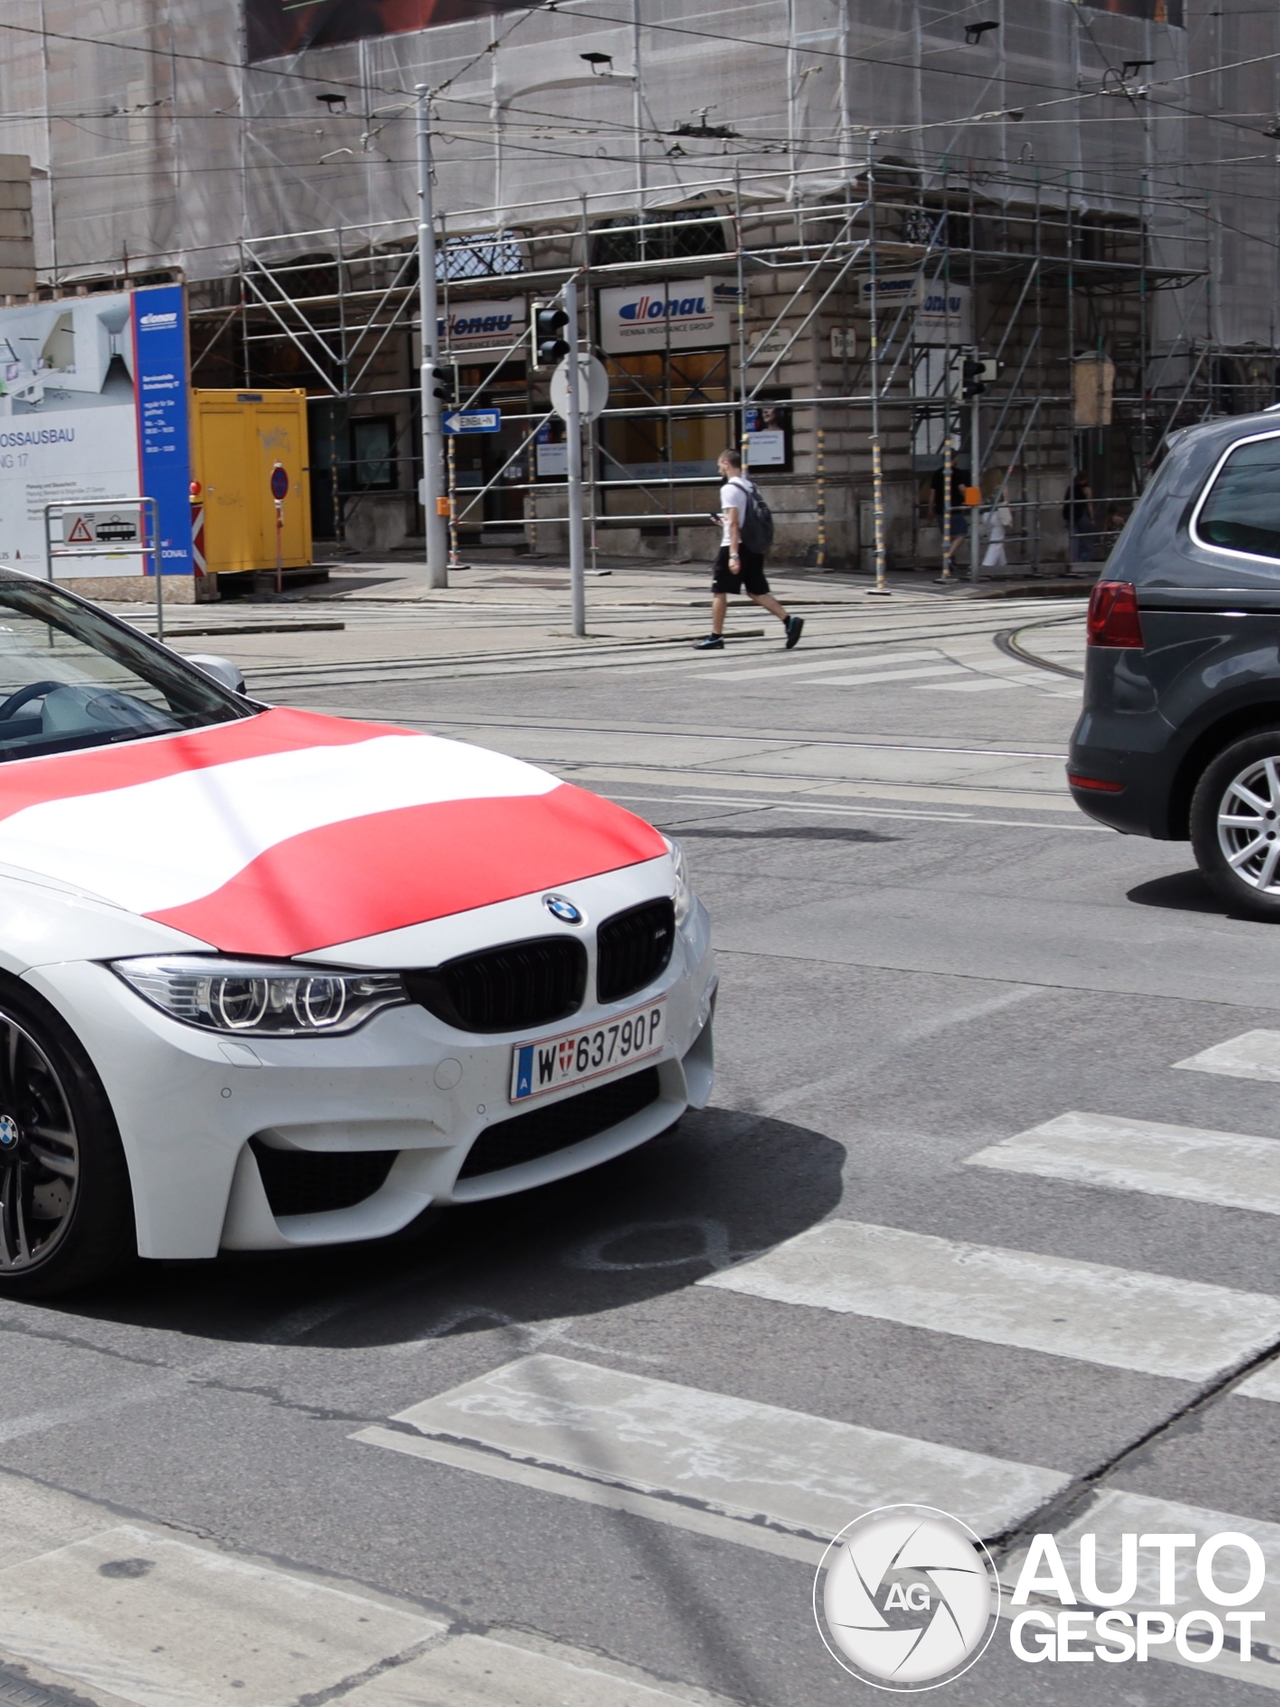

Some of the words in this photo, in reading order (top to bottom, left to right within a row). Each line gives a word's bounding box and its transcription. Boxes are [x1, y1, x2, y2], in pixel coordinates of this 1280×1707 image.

[690, 322, 714, 331] GROUP
[17, 453, 29, 467] 17
[538, 1045, 557, 1085] W
[576, 1008, 662, 1073] 63790P
[519, 1077, 529, 1091] A
